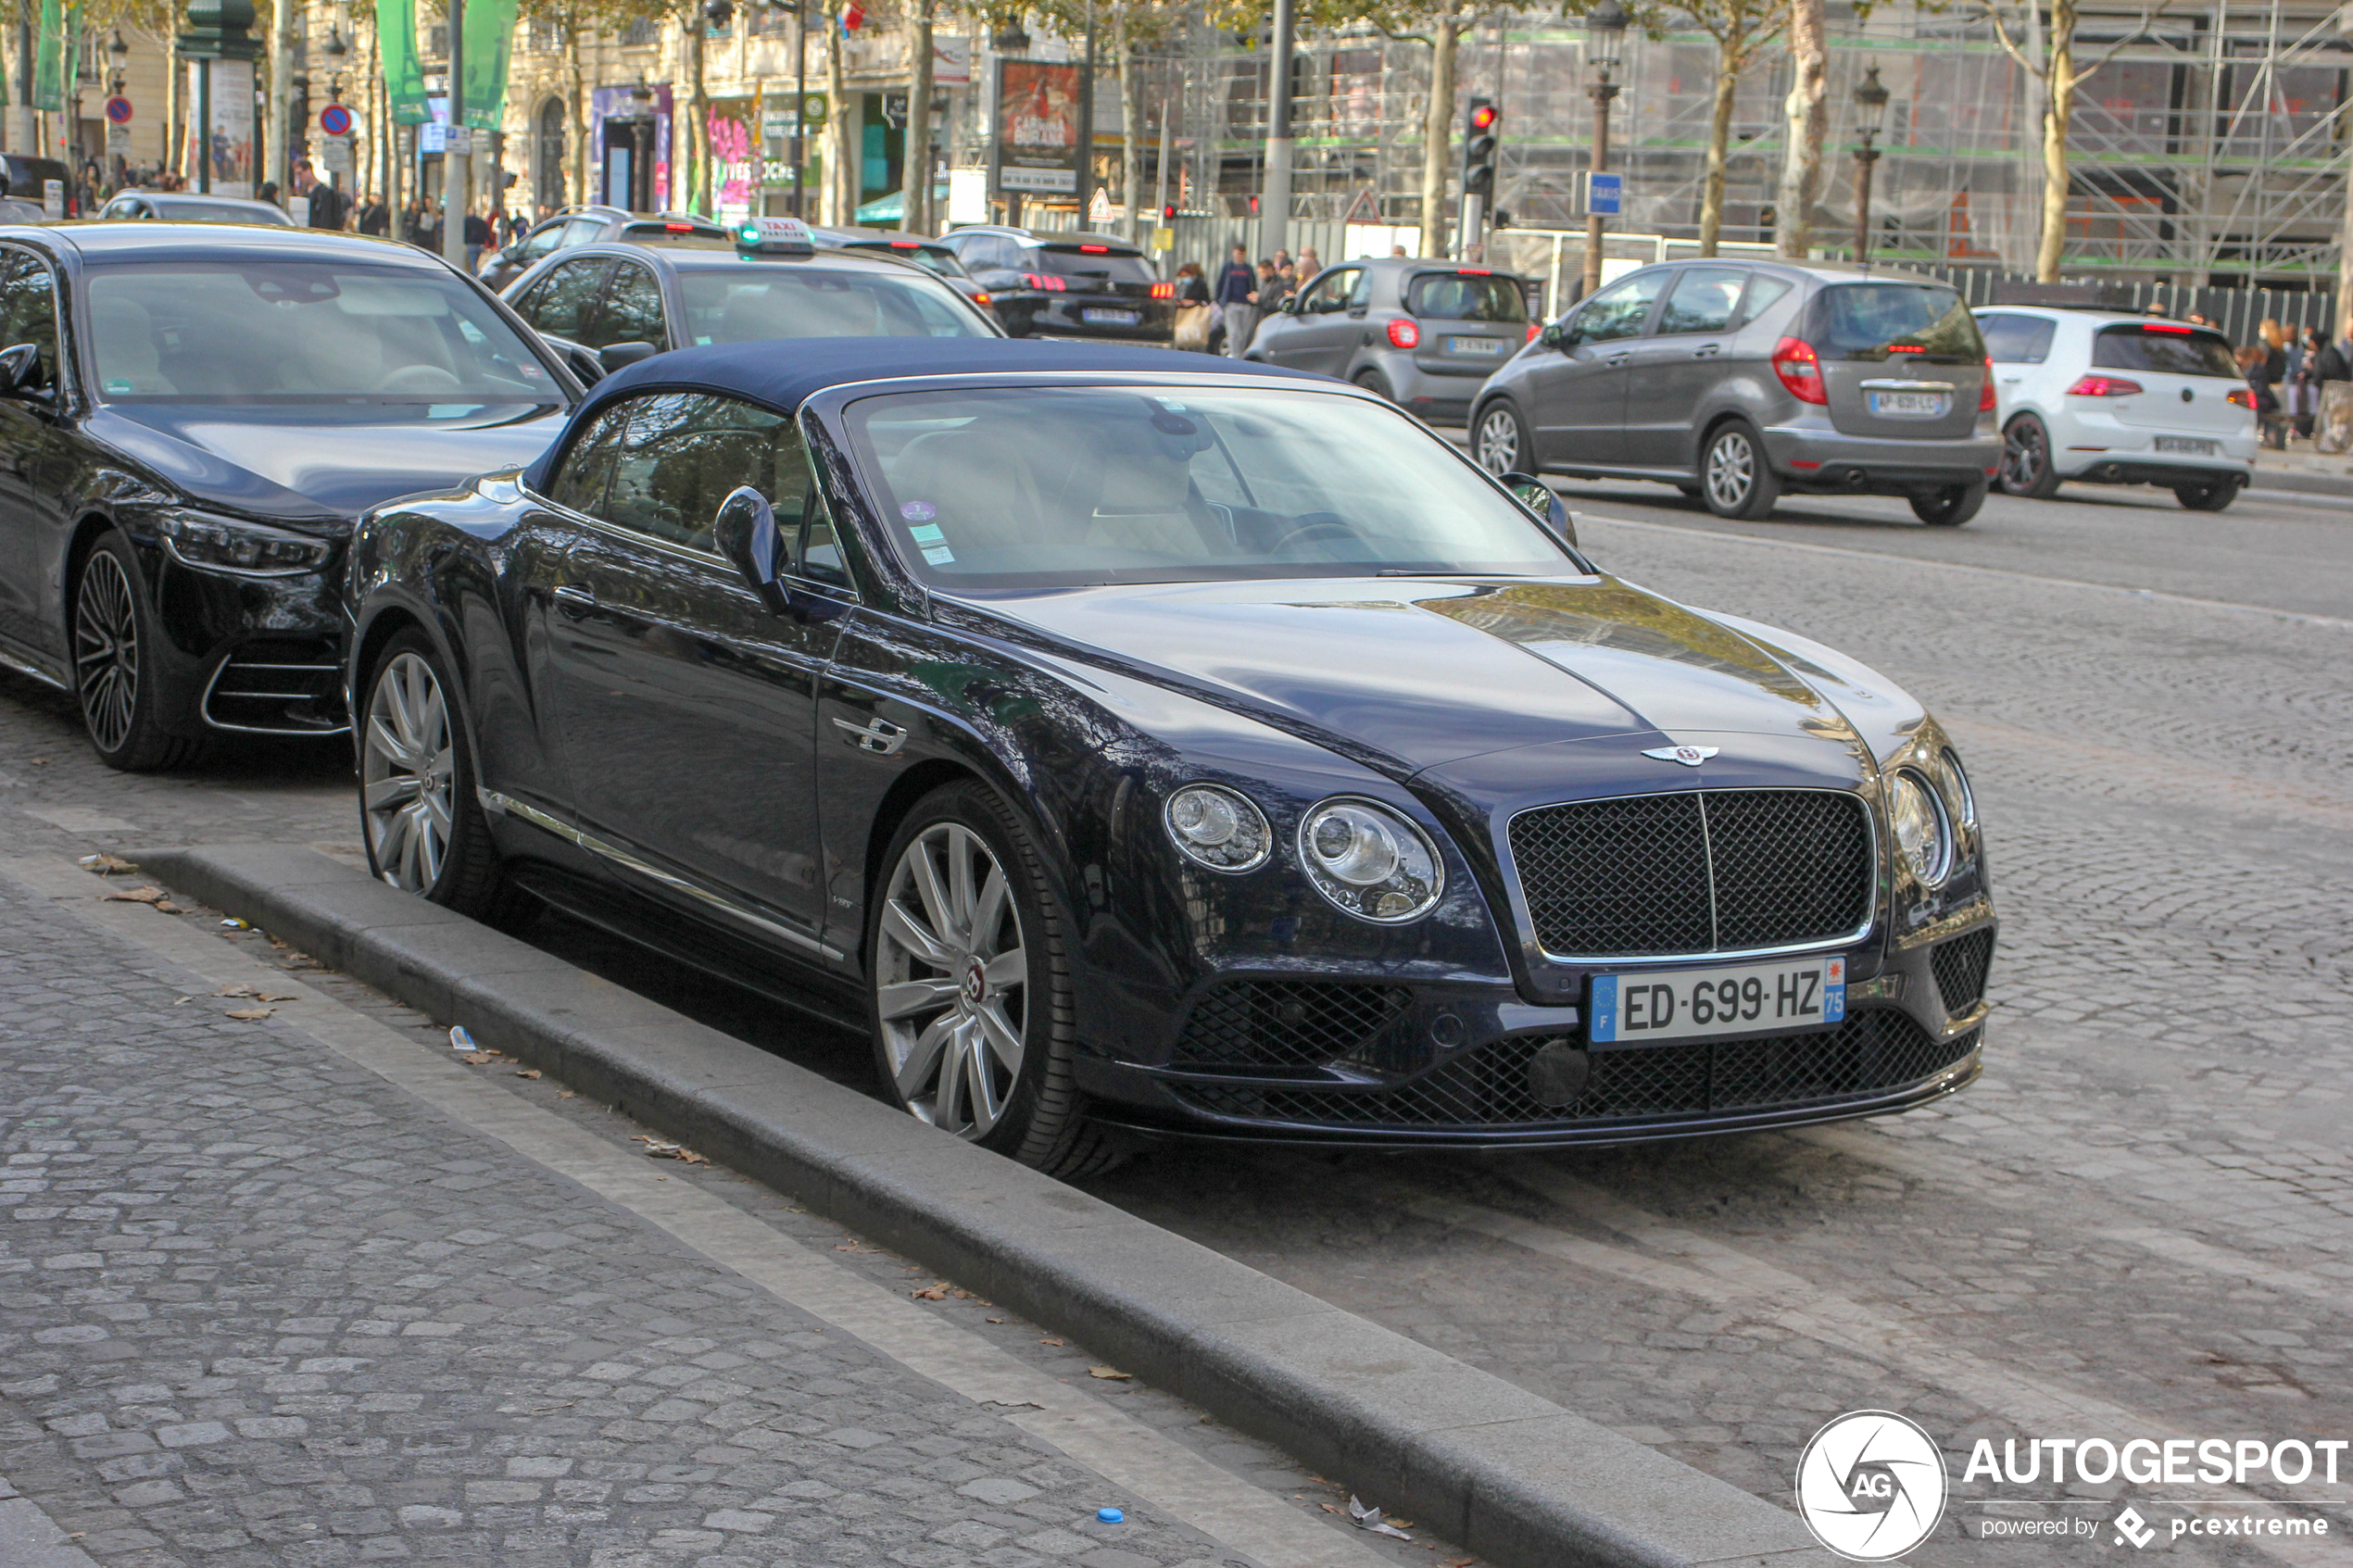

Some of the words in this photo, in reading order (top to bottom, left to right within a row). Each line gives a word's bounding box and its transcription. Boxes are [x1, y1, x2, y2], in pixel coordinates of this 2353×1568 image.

[1013, 131, 1066, 147] BURANA
[761, 161, 796, 181] OCHE
[762, 221, 797, 231] TAXI
[1600, 1015, 1609, 1029] F
[1624, 970, 1821, 1032] ED-699-HZ
[1826, 991, 1844, 1014] 75
